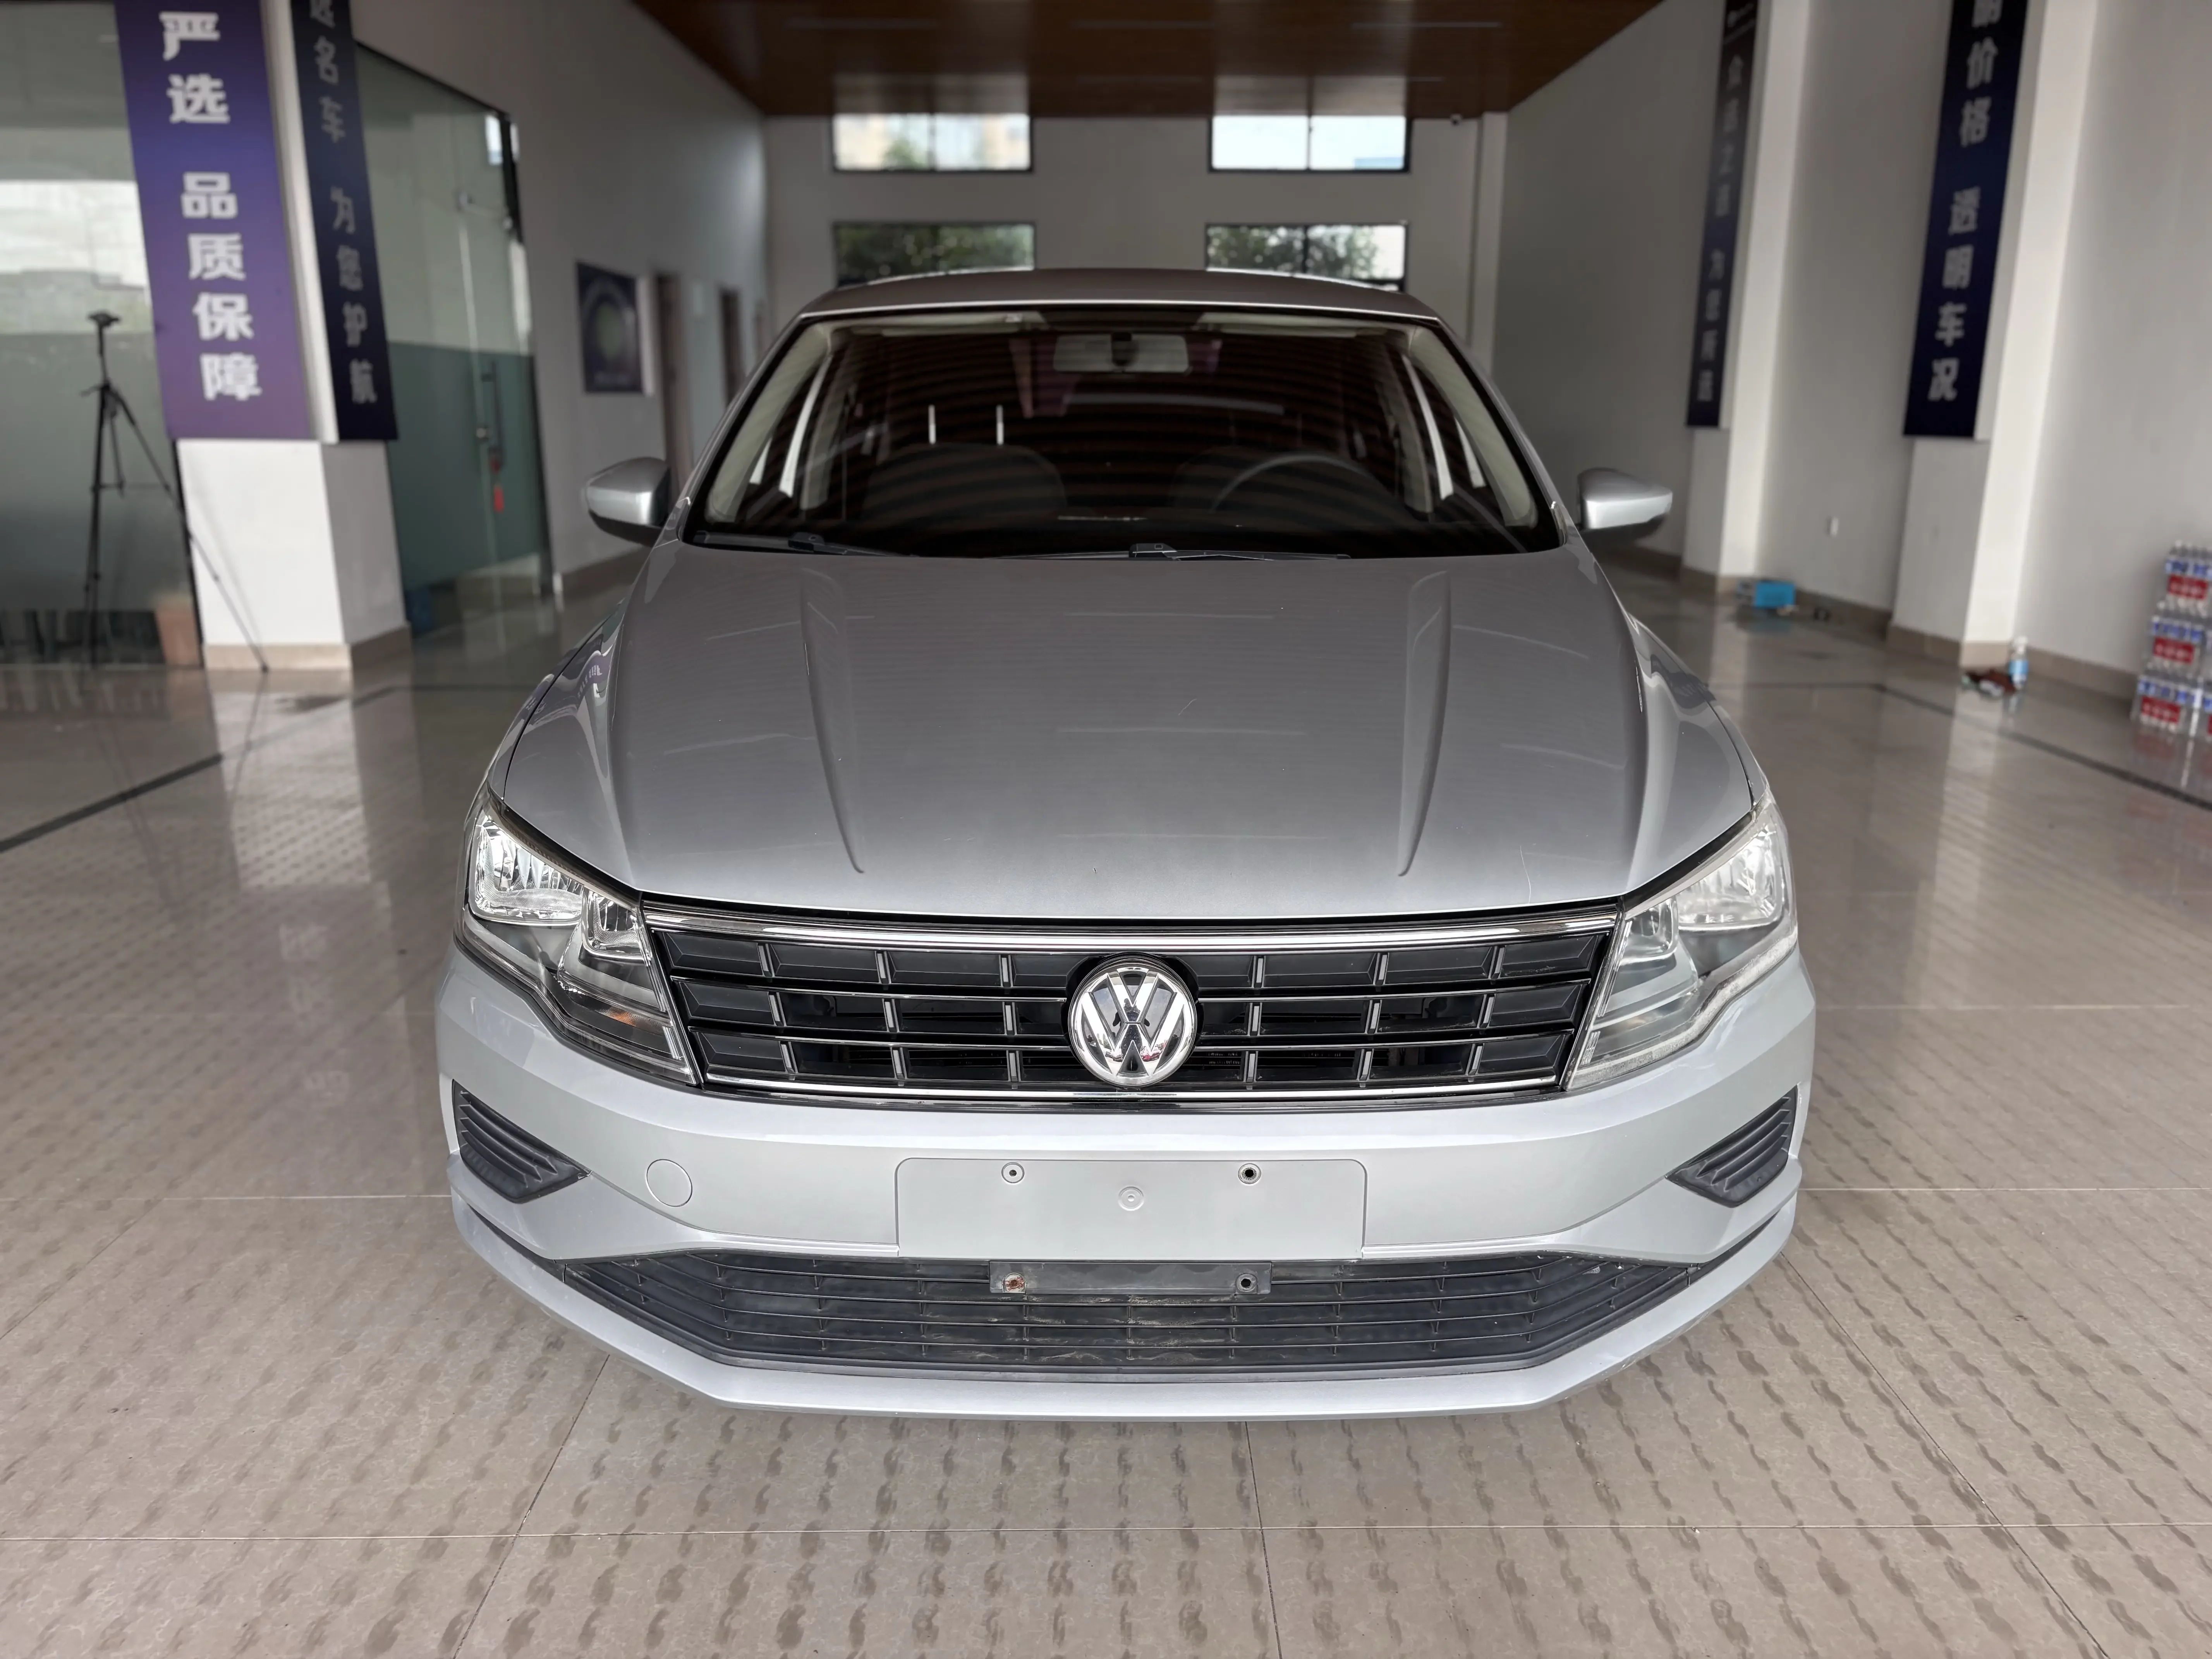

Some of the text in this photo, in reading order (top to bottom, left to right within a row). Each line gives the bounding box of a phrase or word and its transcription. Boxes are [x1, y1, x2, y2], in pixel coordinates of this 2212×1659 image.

[159, 11, 262, 401] 严选 品质保障
